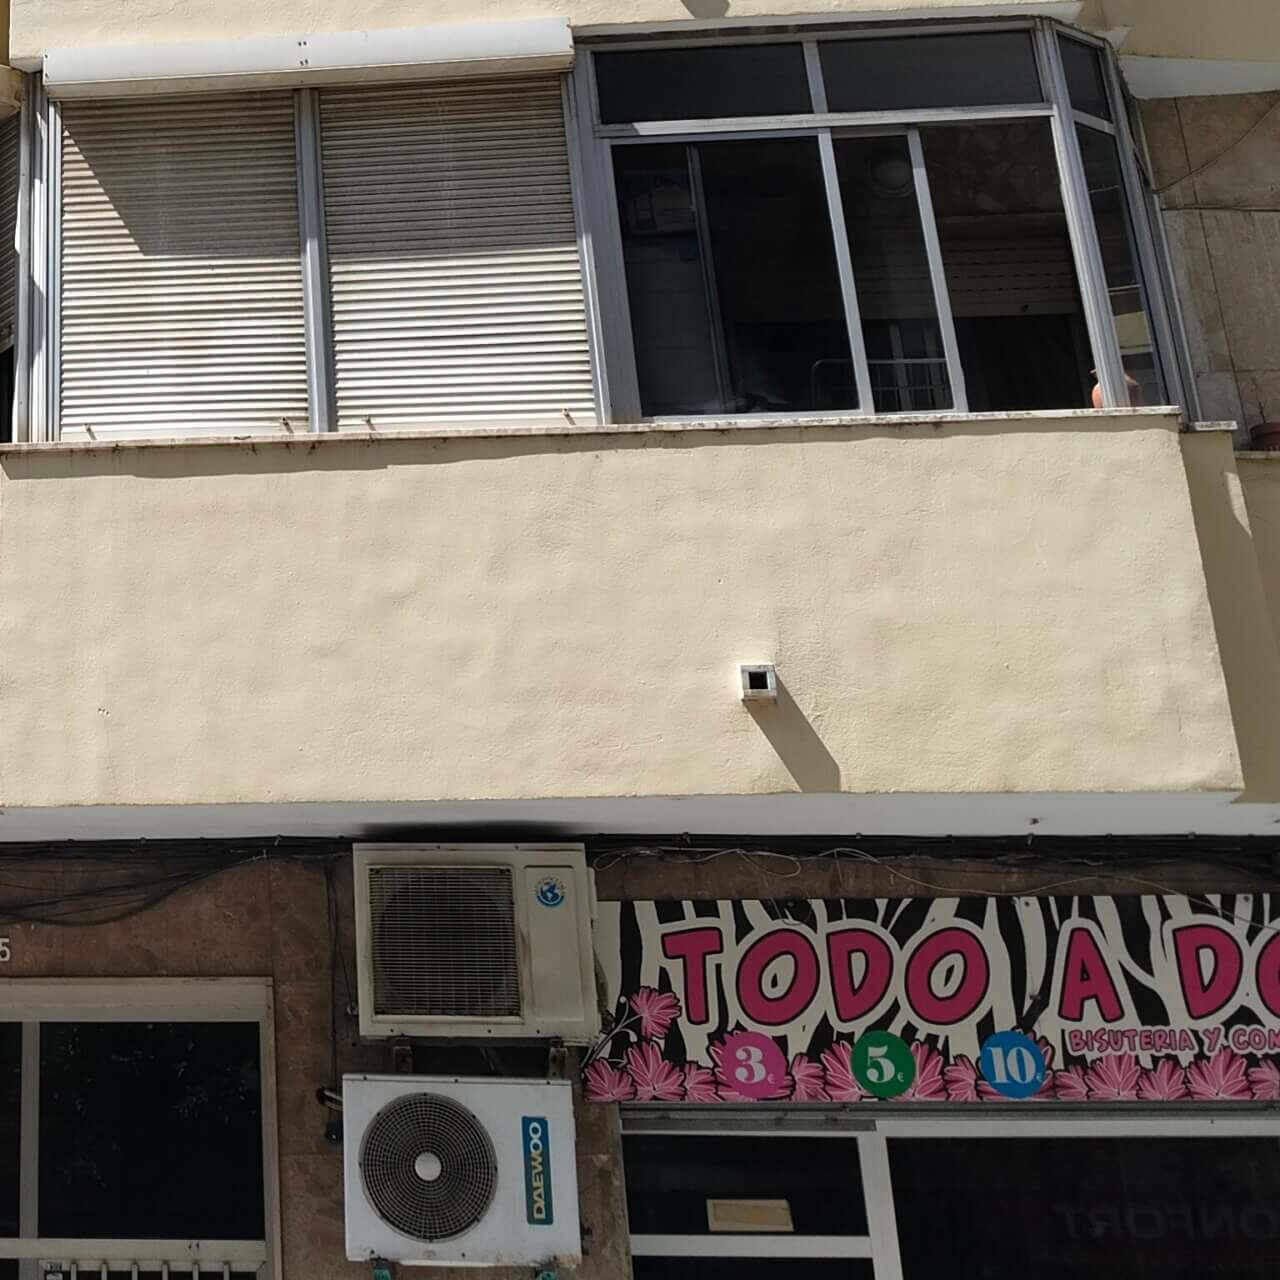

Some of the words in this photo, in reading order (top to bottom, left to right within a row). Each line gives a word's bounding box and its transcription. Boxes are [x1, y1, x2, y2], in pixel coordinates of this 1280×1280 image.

[662, 926, 990, 1026] TODO
[1059, 926, 1122, 1022] A
[1070, 1028, 1196, 1052] BISUTERIA
[1204, 1027, 1221, 1052] Y
[529, 1122, 546, 1219] DAEWOO
